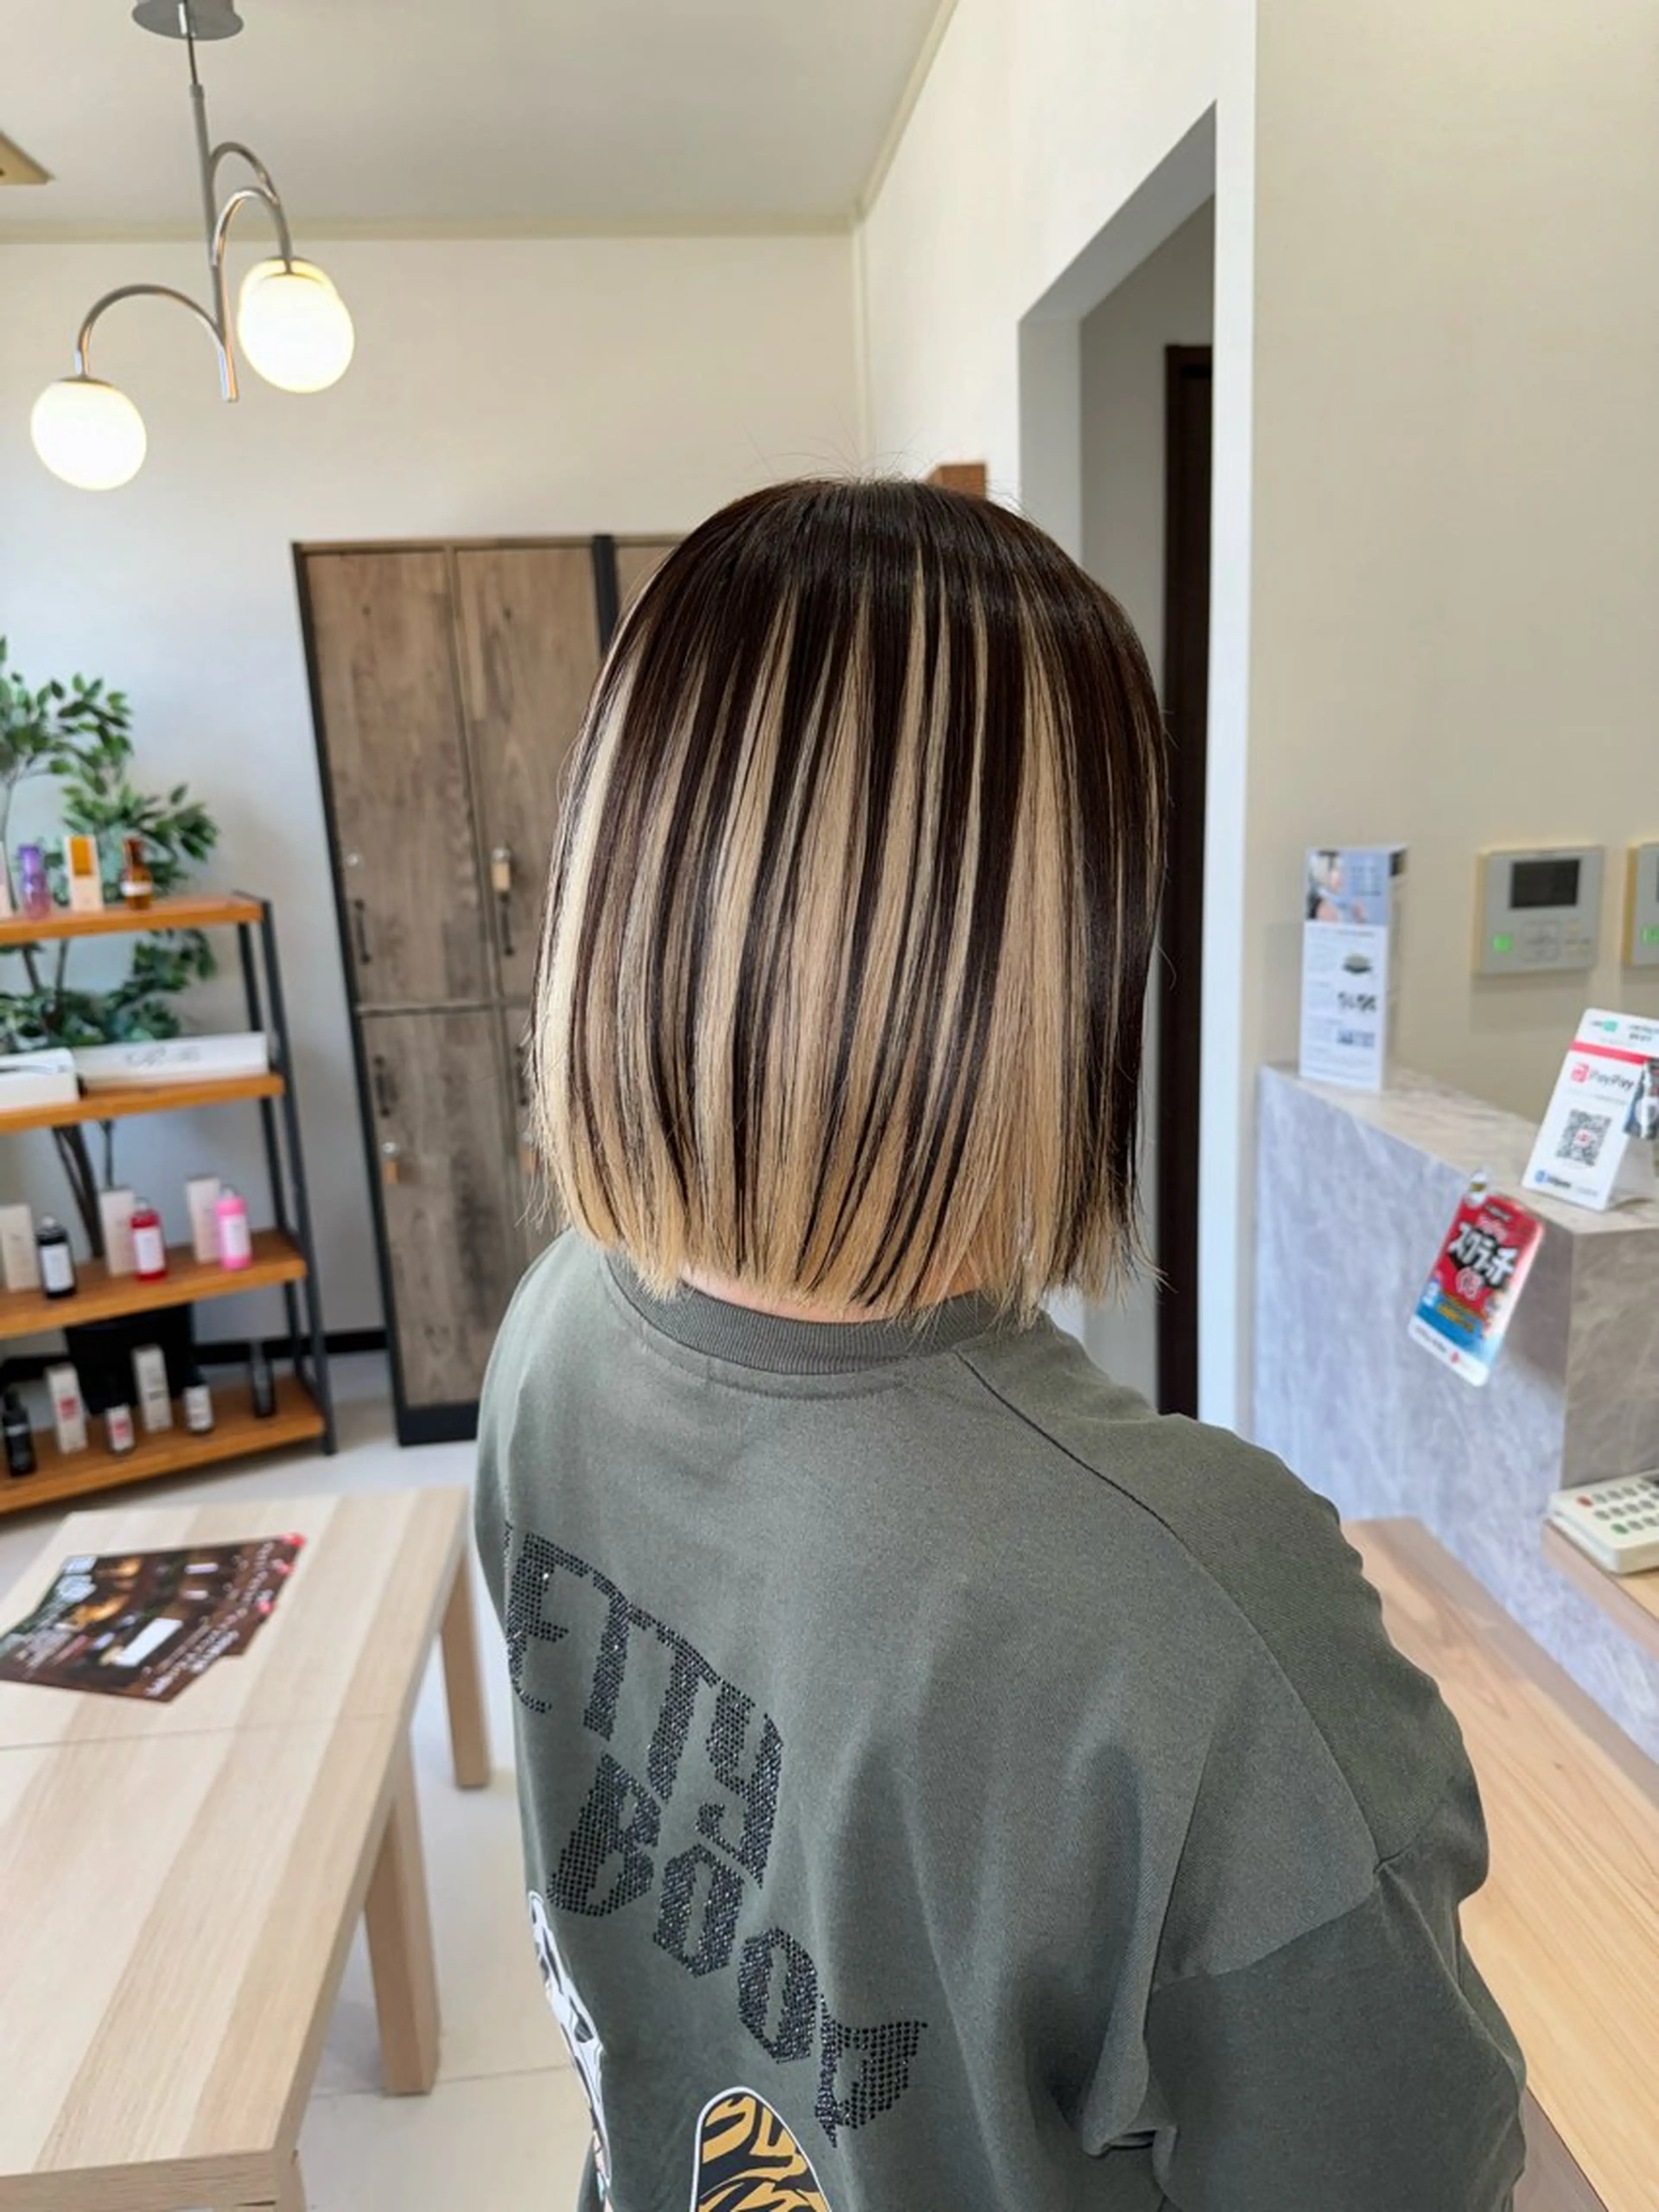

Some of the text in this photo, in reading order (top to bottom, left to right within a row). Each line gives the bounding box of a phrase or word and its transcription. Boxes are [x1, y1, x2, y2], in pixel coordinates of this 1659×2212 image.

[1589, 1068, 1634, 1091] PayPay
[1447, 1222, 1518, 1286] スクラッチ
[504, 1519, 783, 1889] ETTY
[547, 1752, 928, 2148] BOOP
